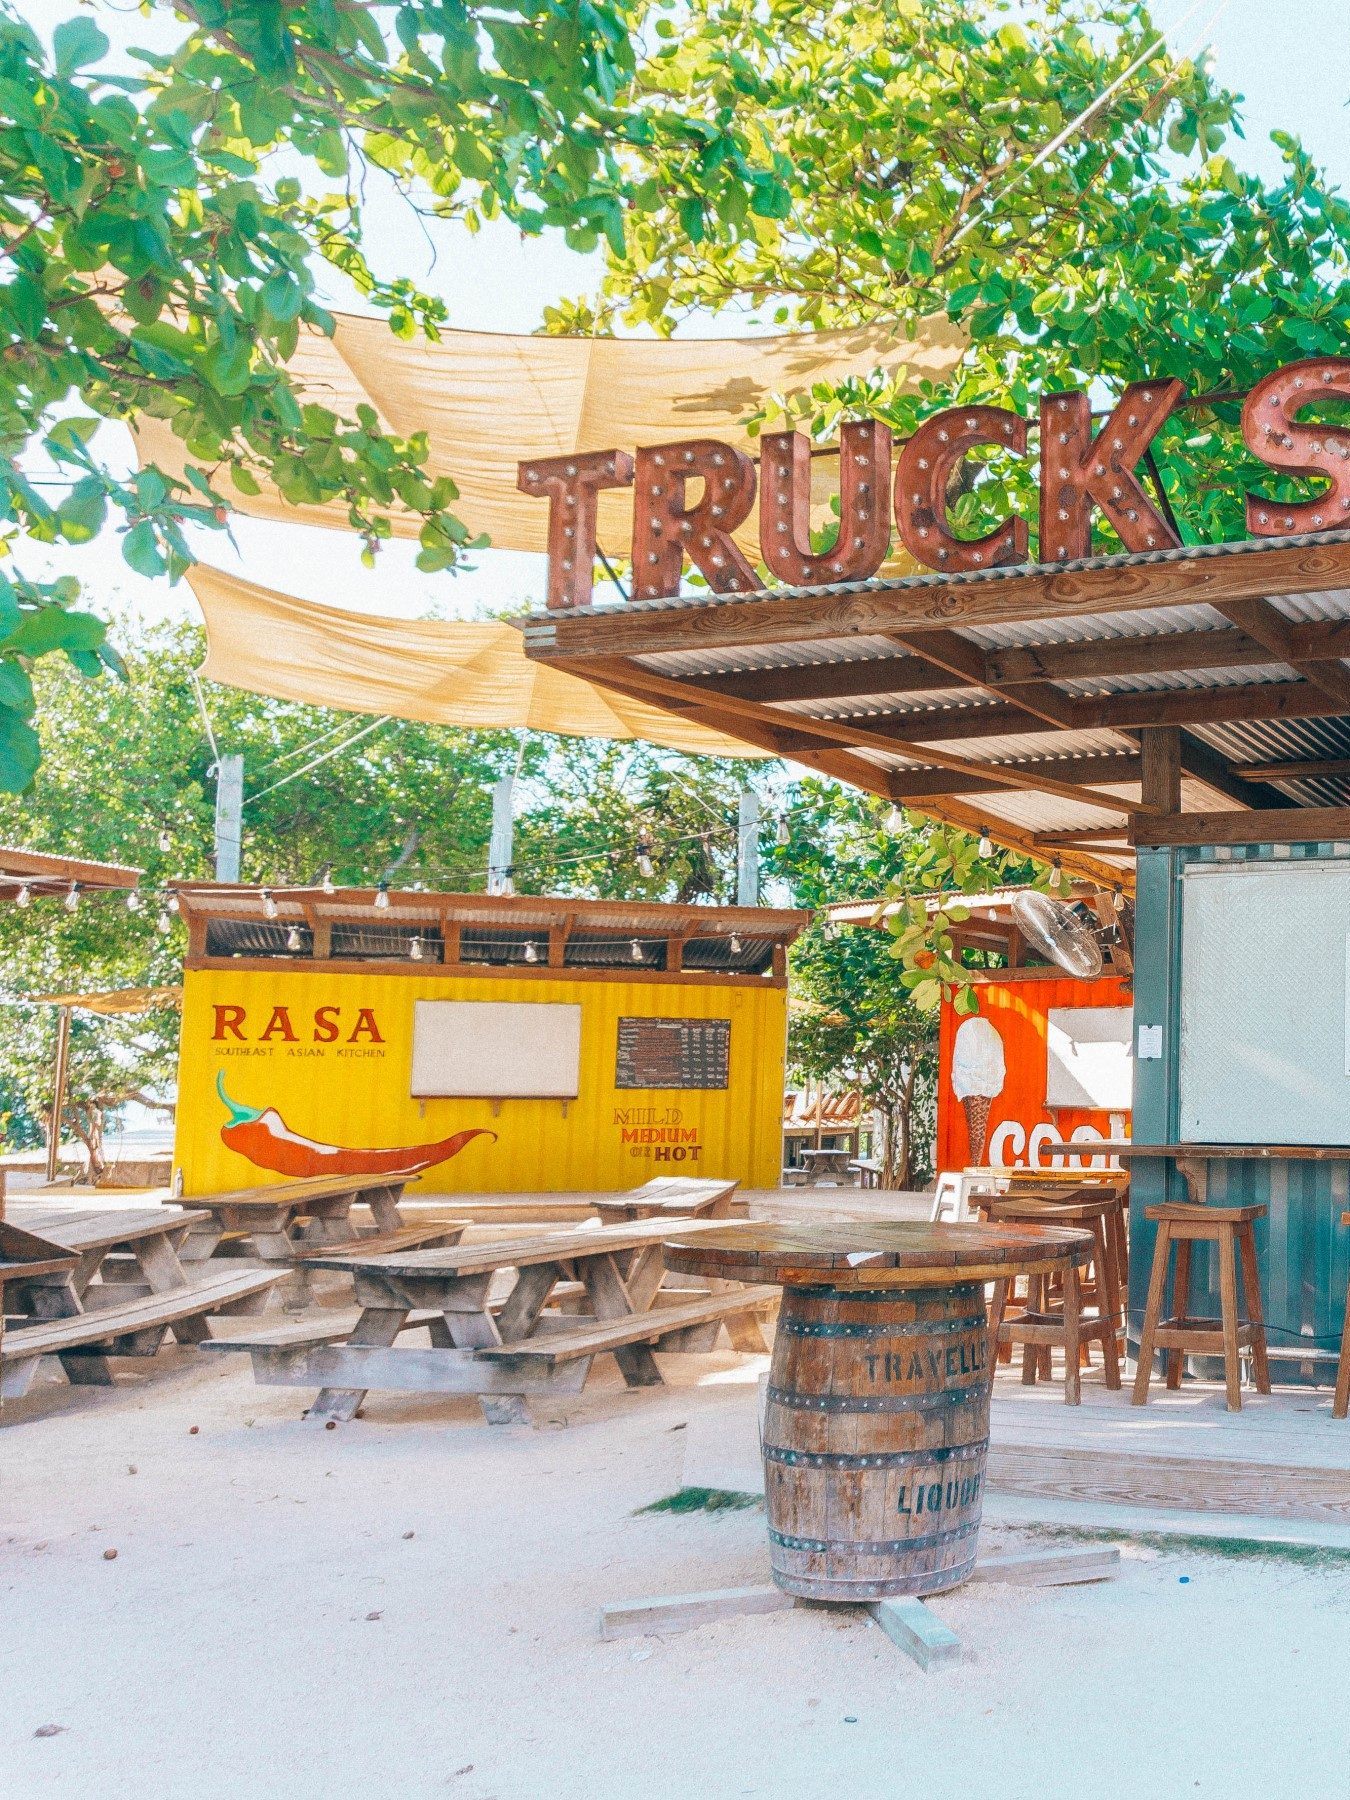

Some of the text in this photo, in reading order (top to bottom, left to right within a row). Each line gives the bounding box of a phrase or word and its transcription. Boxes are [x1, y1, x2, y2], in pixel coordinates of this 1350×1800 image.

[517, 377, 1187, 609] TRUCK
[211, 1004, 386, 1043] RASA
[215, 1047, 385, 1058] SOUTHEAST ASIAN KITCHEN
[613, 1108, 683, 1125] MILD
[621, 1128, 698, 1144] MEDIUM
[654, 1146, 702, 1162] HOT
